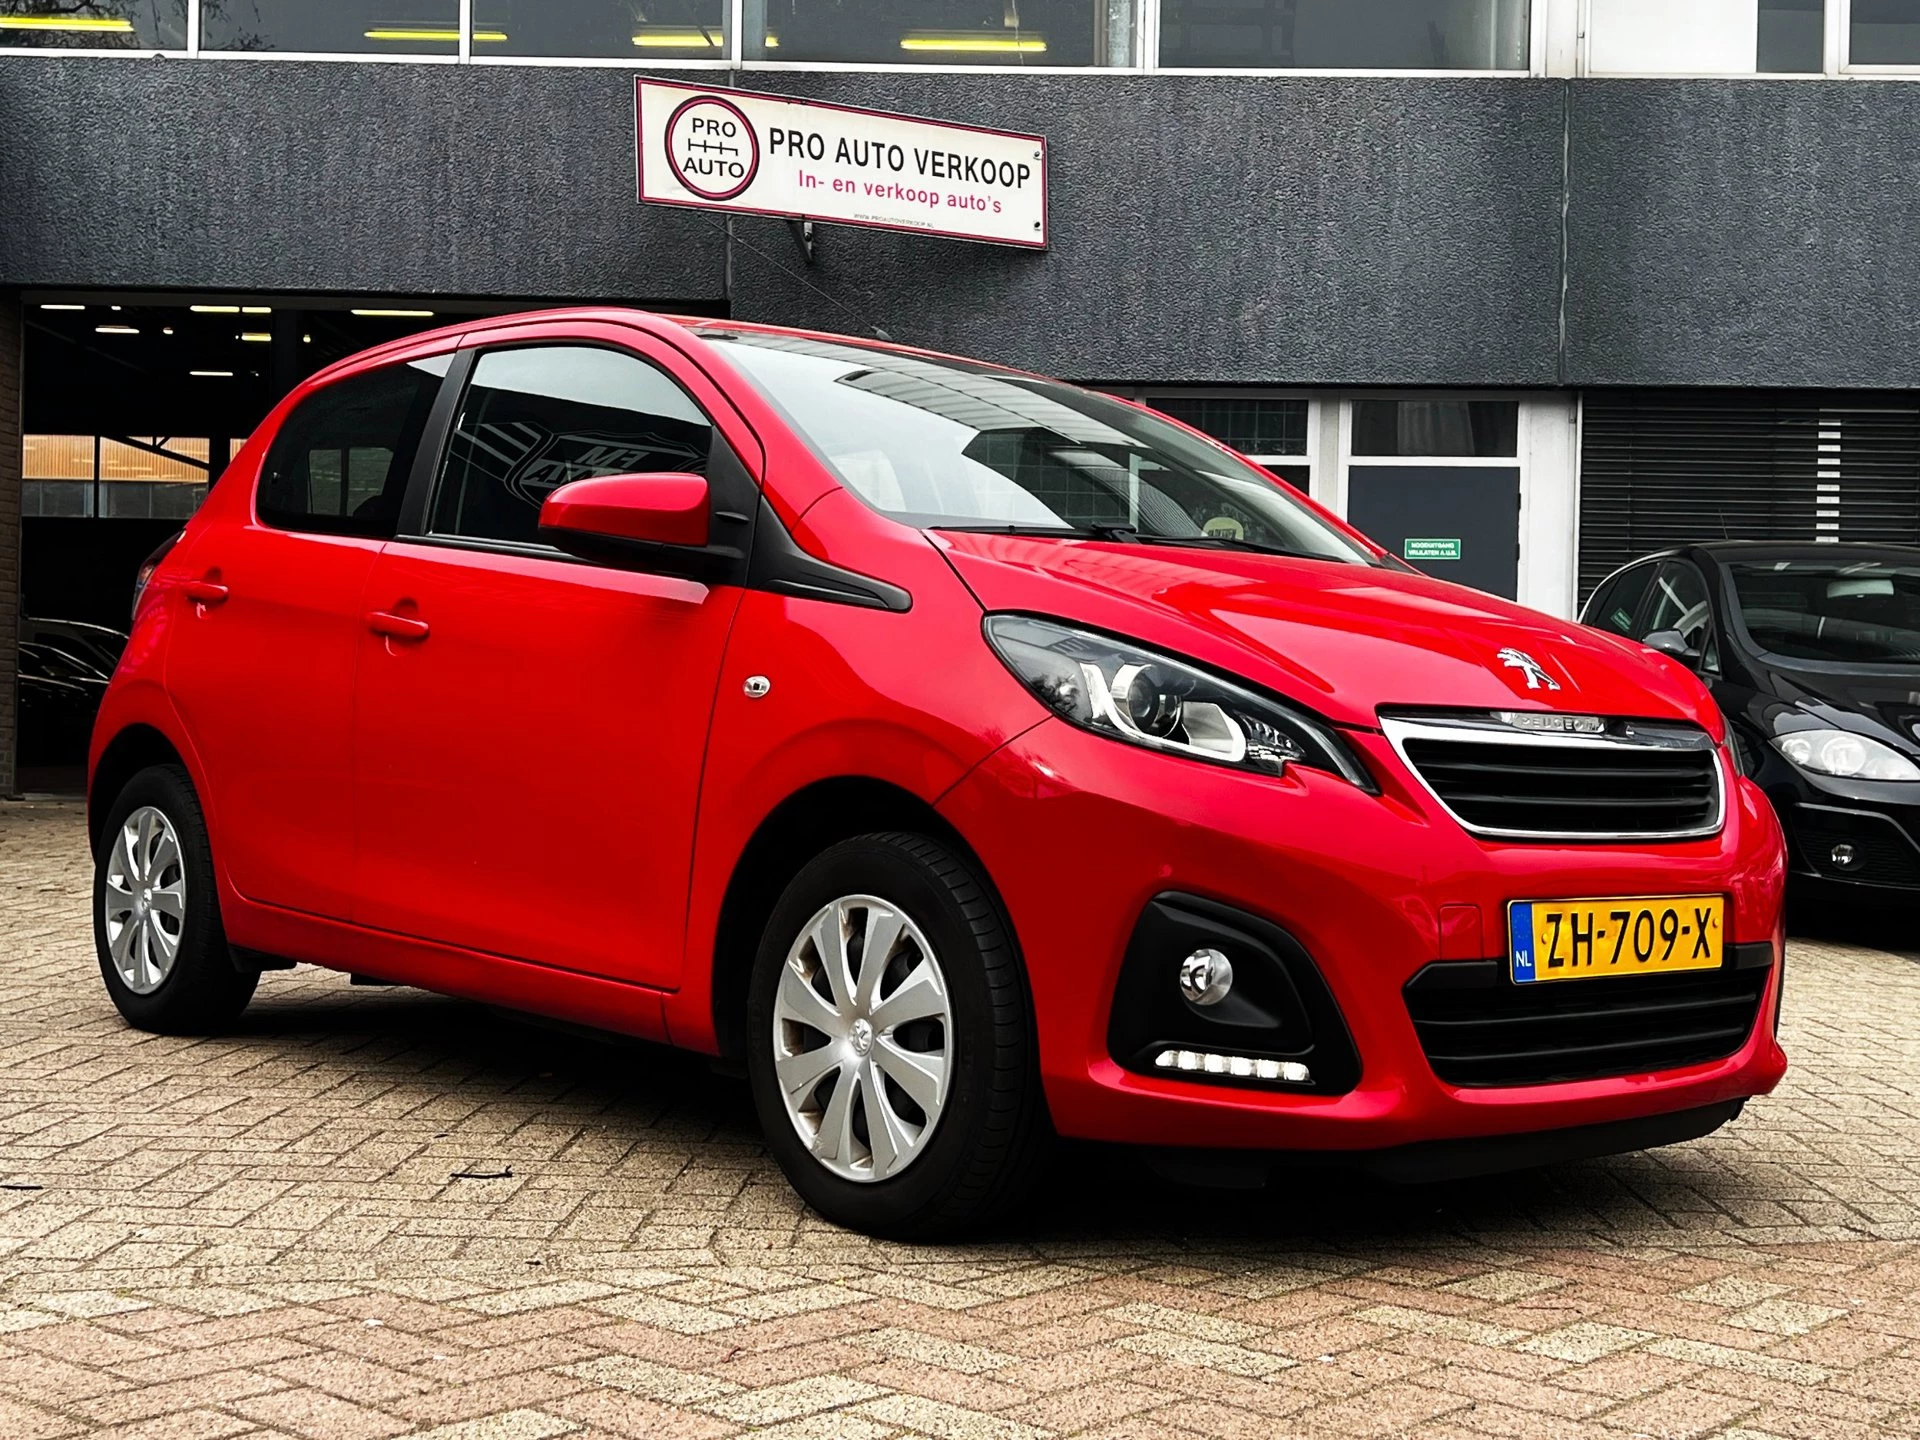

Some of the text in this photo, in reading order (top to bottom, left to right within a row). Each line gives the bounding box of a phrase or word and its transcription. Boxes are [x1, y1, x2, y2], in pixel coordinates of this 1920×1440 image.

[691, 117, 737, 139] PRO
[683, 157, 745, 179] AUTO
[769, 127, 1031, 189] PRO AUTO VERKOOP
[799, 169, 1002, 213] In- en verkoop auto's
[1546, 907, 1712, 969] ZH-709-X
[1516, 950, 1532, 967] NL
